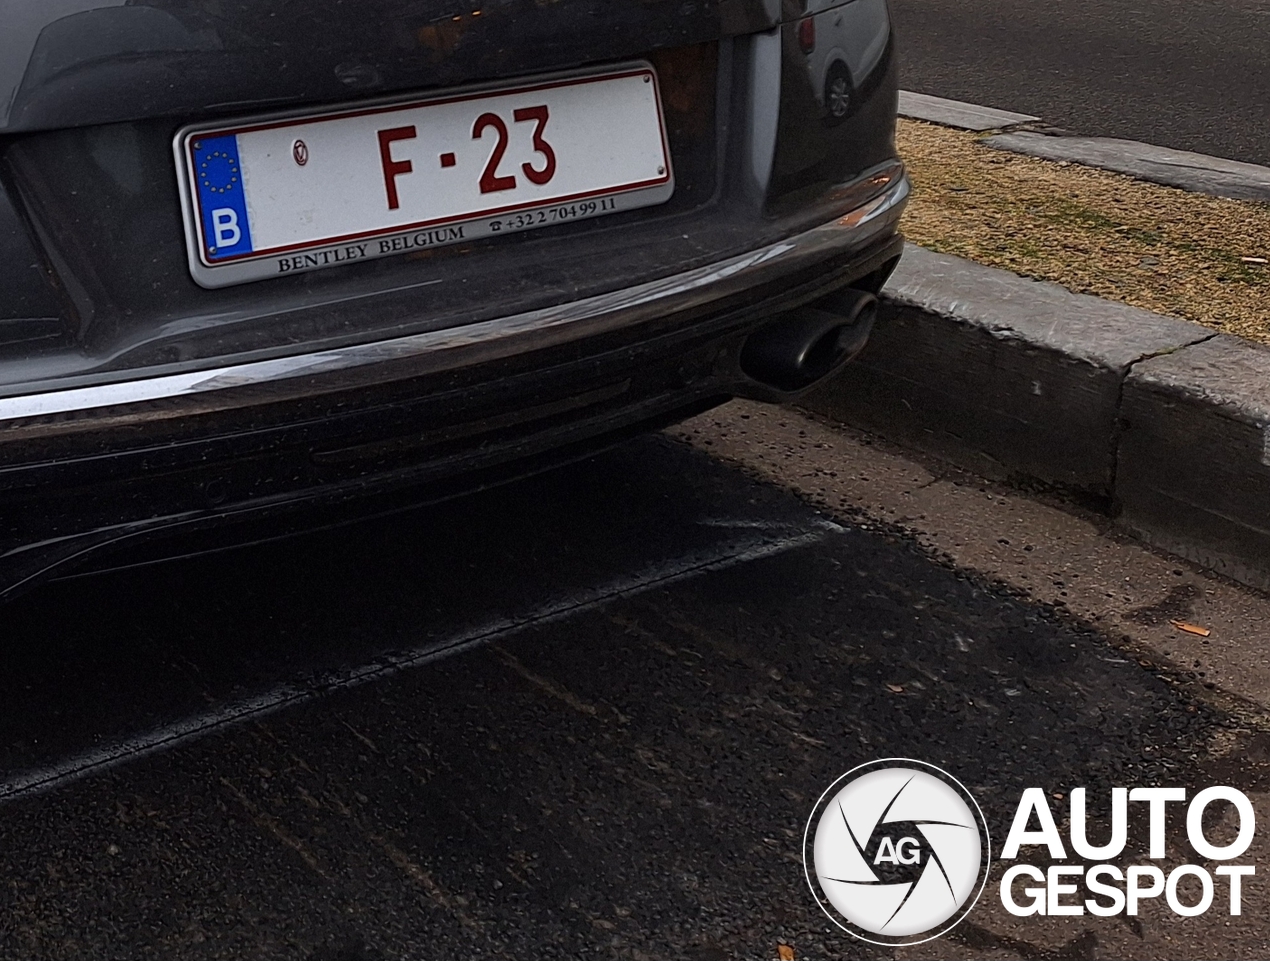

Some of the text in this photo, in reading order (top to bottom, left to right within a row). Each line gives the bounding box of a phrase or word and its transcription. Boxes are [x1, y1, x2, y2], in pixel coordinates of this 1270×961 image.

[210, 207, 241, 248] B
[278, 244, 368, 273] BENTLEY
[379, 226, 466, 254] BELGIUM
